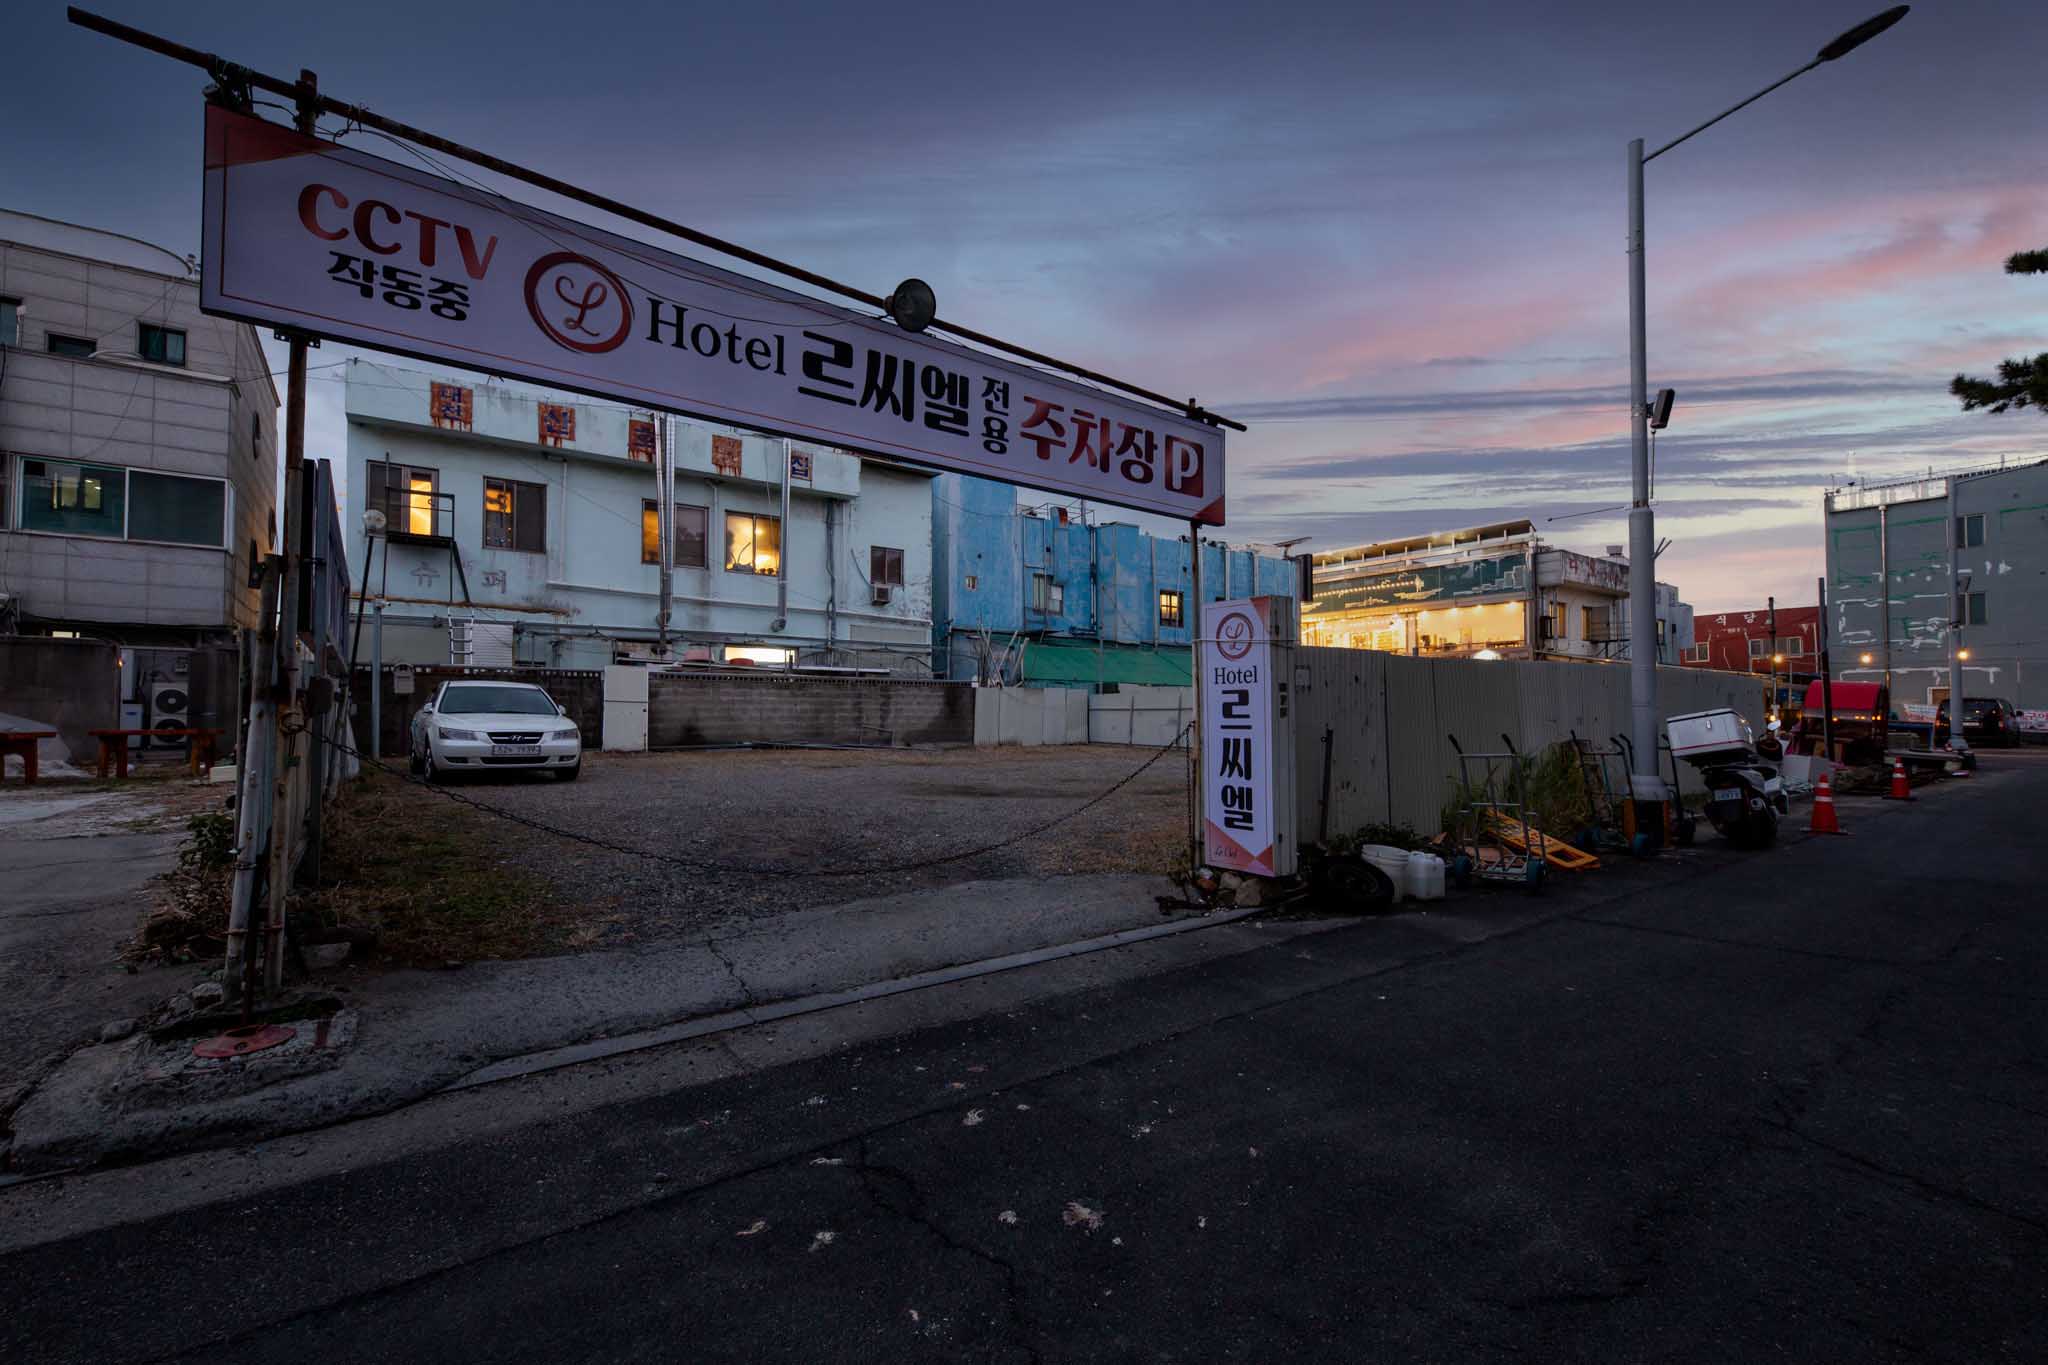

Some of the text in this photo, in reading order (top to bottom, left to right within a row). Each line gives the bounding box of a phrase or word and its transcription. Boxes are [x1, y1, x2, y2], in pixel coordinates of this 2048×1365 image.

[298, 183, 498, 280] CCTV
[327, 250, 471, 322] 작동중
[646, 297, 788, 377] Hotel
[797, 329, 971, 437] 르씨엘
[980, 375, 1011, 455] 전용
[1019, 395, 1159, 484] 주차장
[1214, 665, 1258, 685] Hotel
[1219, 689, 1254, 832] 르씨엘
